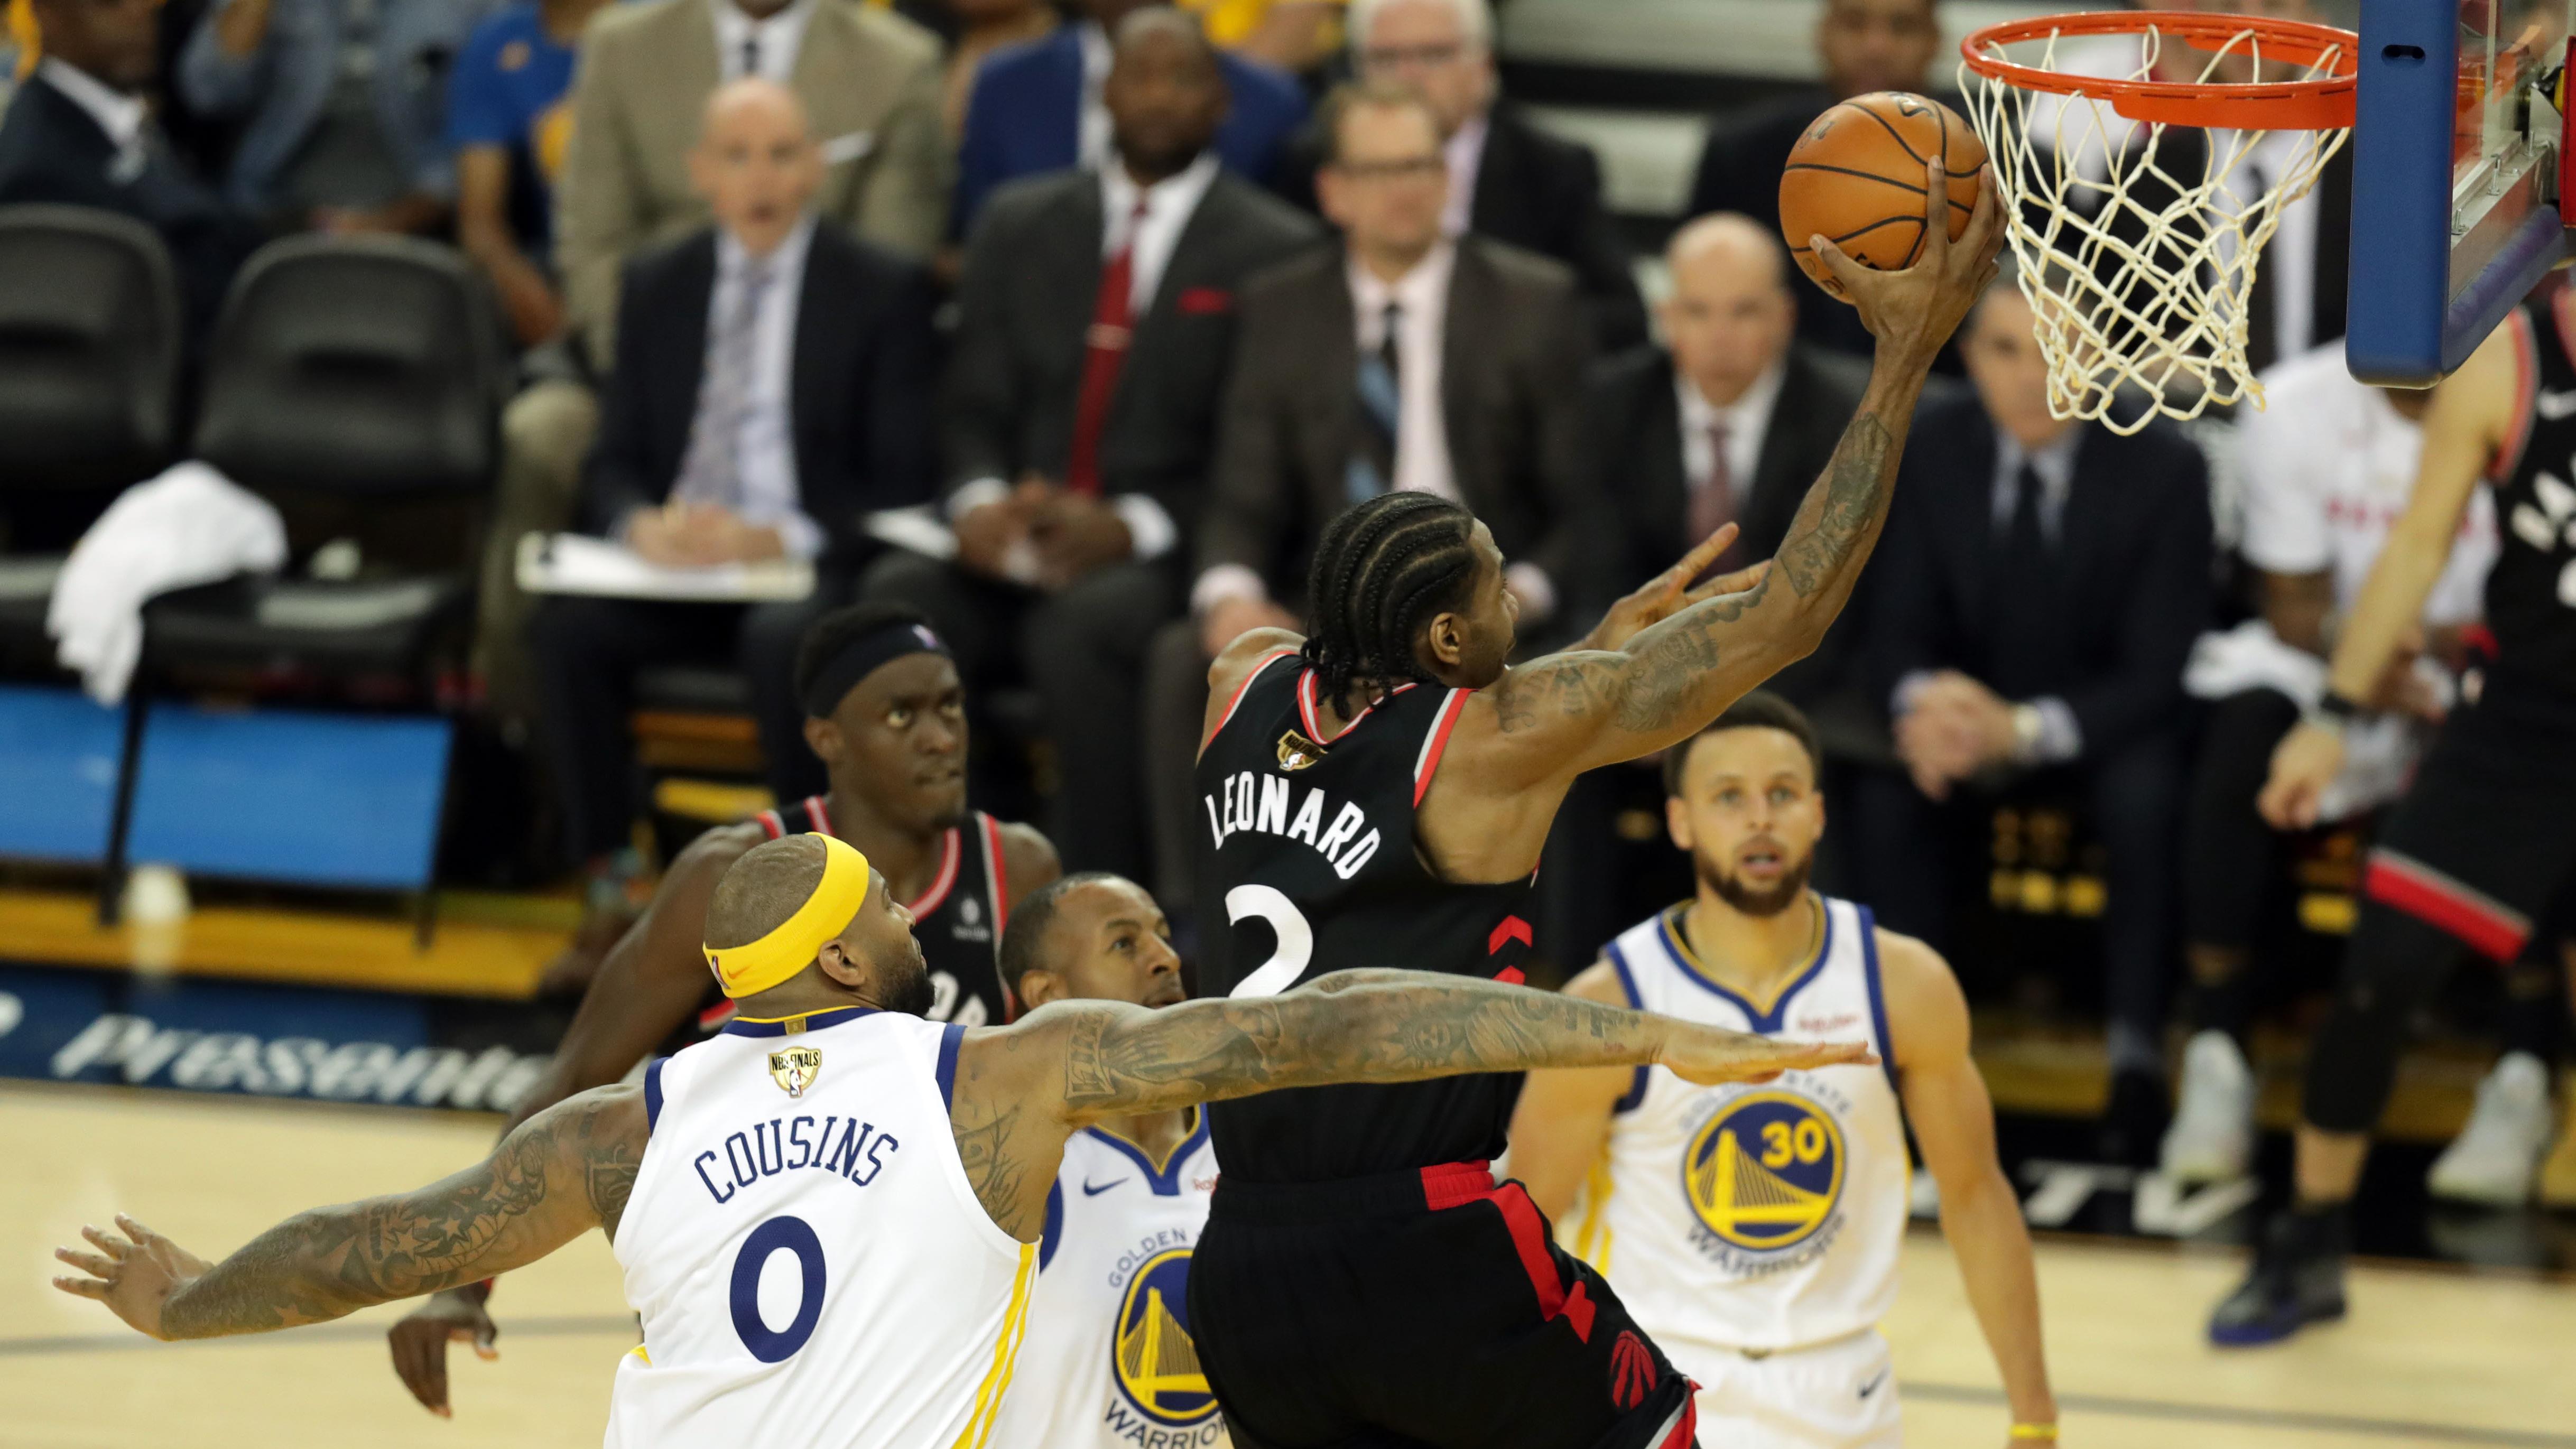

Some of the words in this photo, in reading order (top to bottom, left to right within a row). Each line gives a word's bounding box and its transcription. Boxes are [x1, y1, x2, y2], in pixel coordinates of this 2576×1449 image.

[1204, 771, 1380, 879] LEONARD
[1225, 884, 1313, 998] 2
[694, 1116, 898, 1203] COUSINS
[1760, 1117, 1827, 1169] 30
[729, 1215, 827, 1363] 0
[1108, 1228, 1188, 1287] GOLDEN
